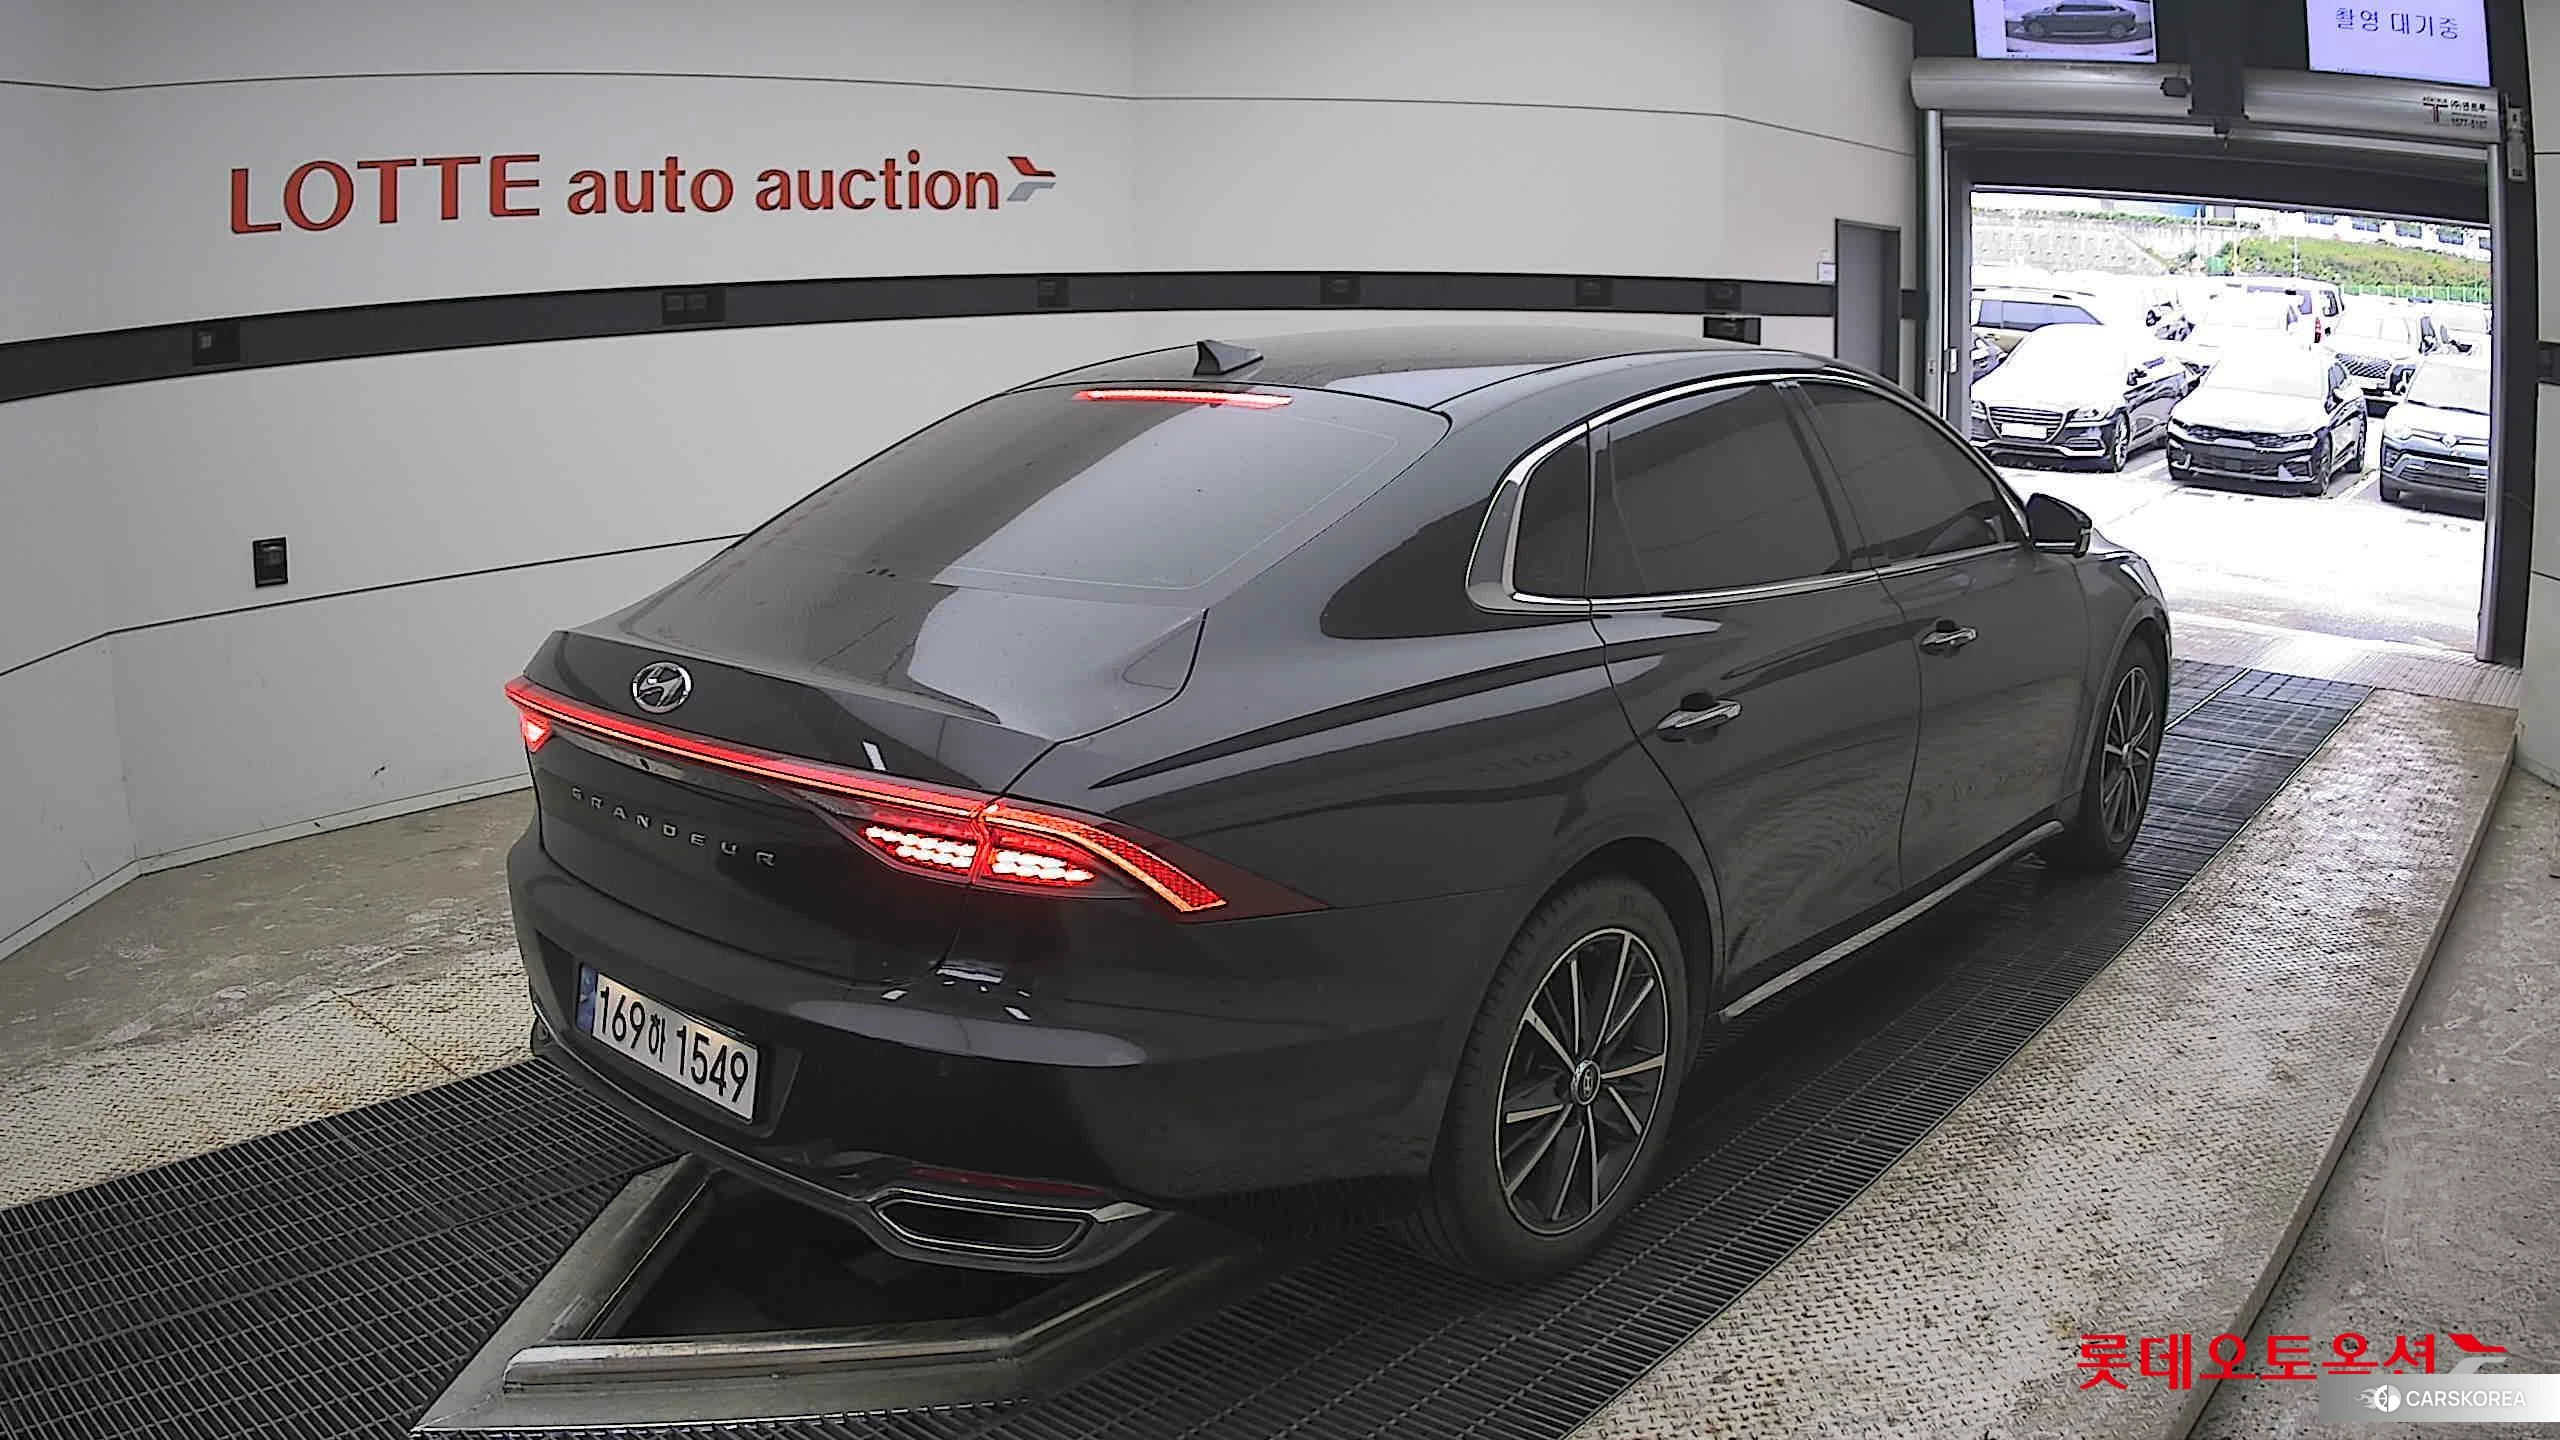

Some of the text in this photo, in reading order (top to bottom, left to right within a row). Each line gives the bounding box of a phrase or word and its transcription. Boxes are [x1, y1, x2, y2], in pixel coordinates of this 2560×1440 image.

[2335, 8, 2458, 40] 촬영 대기중
[230, 149, 1001, 234] LOTTE auto auction
[571, 786, 776, 867] GRANDEUR
[676, 1024, 750, 1104] 1549
